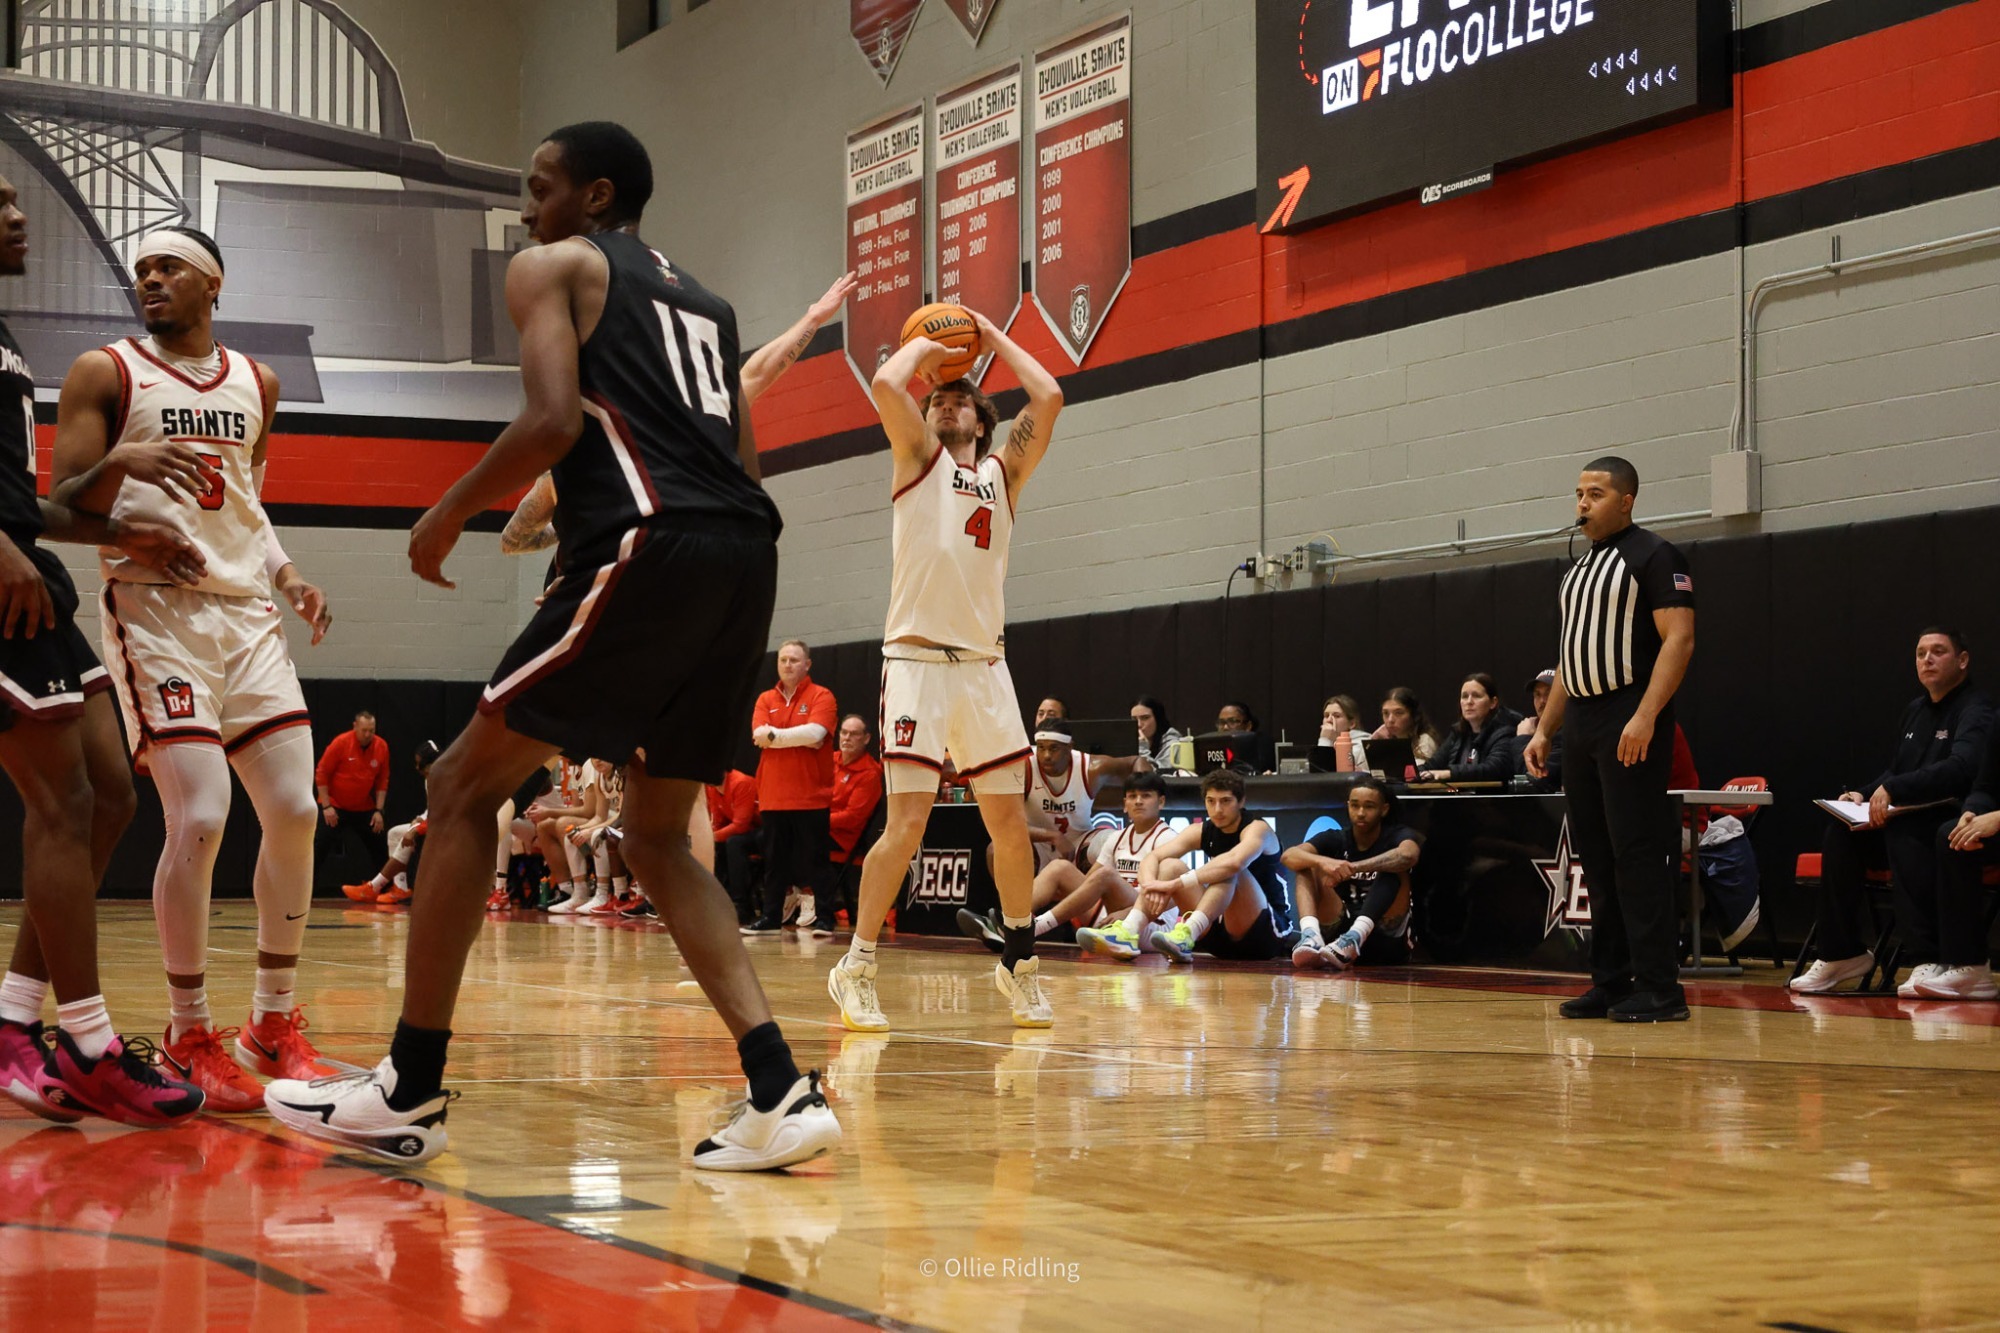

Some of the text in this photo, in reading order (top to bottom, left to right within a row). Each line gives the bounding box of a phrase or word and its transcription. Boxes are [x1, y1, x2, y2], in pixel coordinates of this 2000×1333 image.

[1045, 76, 1117, 120] MEN'S VOLLEYBALL
[1327, 66, 1354, 105] ON
[945, 119, 1009, 159] MEN'S VOLLEYBALL
[1040, 119, 1124, 167] CONFERENCE CHAMPIONS
[855, 159, 913, 196] MEN'S VOLLEYBALL
[957, 159, 997, 190] CONFERENCE
[1042, 168, 1062, 190] 1999
[1421, 173, 1491, 203] OES SCOREBOARDS
[880, 198, 916, 227] TOURNAMENT
[940, 177, 1016, 220] TOURNAMENT CHAMPIONS
[1042, 193, 1062, 215] 2000
[943, 212, 987, 242] 1999 2006
[1042, 217, 1062, 240] 2001
[858, 239, 873, 257] 1999
[942, 236, 987, 266] 2000 2007
[1042, 242, 1062, 265] 2006
[857, 260, 873, 278] 2000
[942, 269, 960, 289] 2001
[857, 282, 873, 301] 2001
[923, 315, 974, 334] Wilson
[652, 299, 731, 426] 10
[195, 452, 226, 511] 5
[965, 505, 993, 550] 4
[167, 694, 191, 713] DY
[897, 729, 912, 742] DY
[919, 856, 968, 898] ECC
